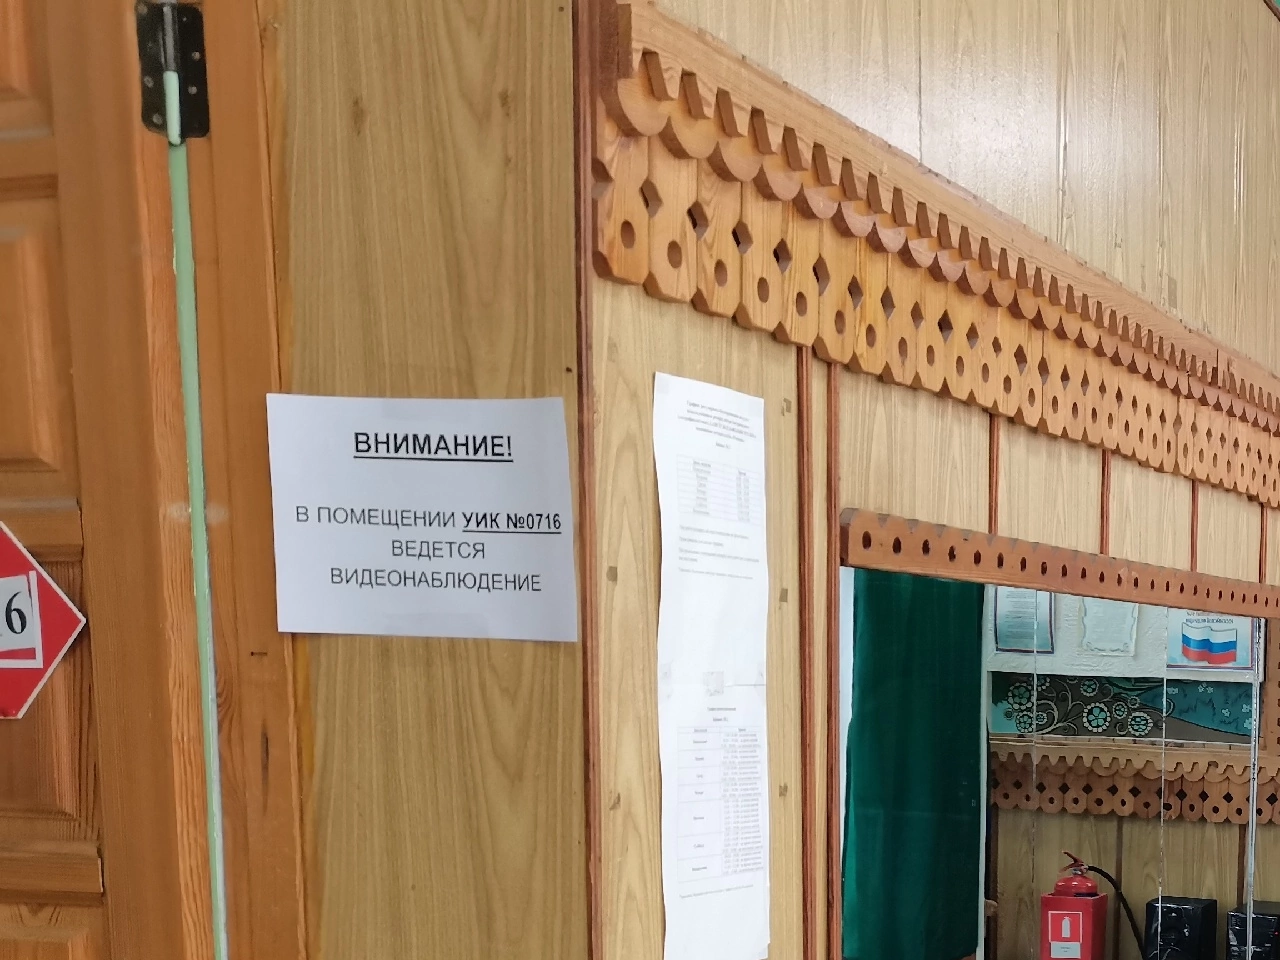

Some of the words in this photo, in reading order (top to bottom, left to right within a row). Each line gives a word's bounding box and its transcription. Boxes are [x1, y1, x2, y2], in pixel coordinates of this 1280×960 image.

[354, 431, 513, 458] ВНИМАНИЕ!
[296, 506, 309, 522] В
[317, 507, 455, 529] ПОМЕЩЕНИИ
[463, 512, 500, 529] УИК
[506, 512, 562, 530] №0716
[392, 540, 485, 561] ВЕДЕТСЯ
[331, 568, 542, 593] ВИДЕОНАБЛЮДЕНИЕ
[5, 591, 27, 634] 6
